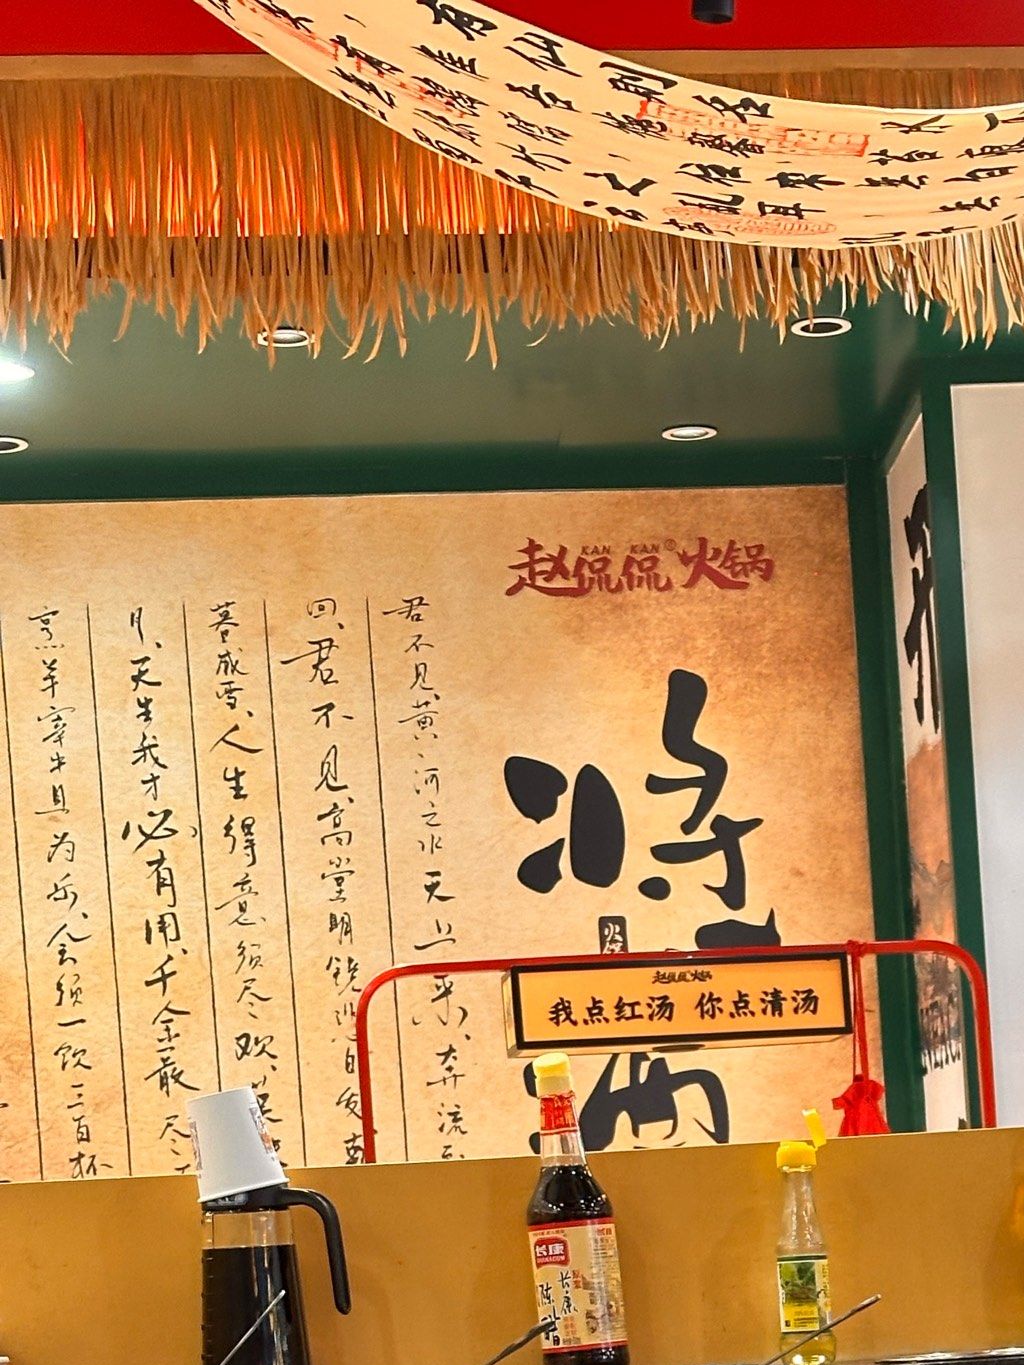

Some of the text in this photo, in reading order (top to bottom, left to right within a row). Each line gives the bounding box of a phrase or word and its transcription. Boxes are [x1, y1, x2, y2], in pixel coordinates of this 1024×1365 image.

[505, 537, 774, 597] 赵侃侃火锅
[580, 544, 660, 556] KAN KAN
[548, 986, 820, 1027] 我点红汤 你点清汤
